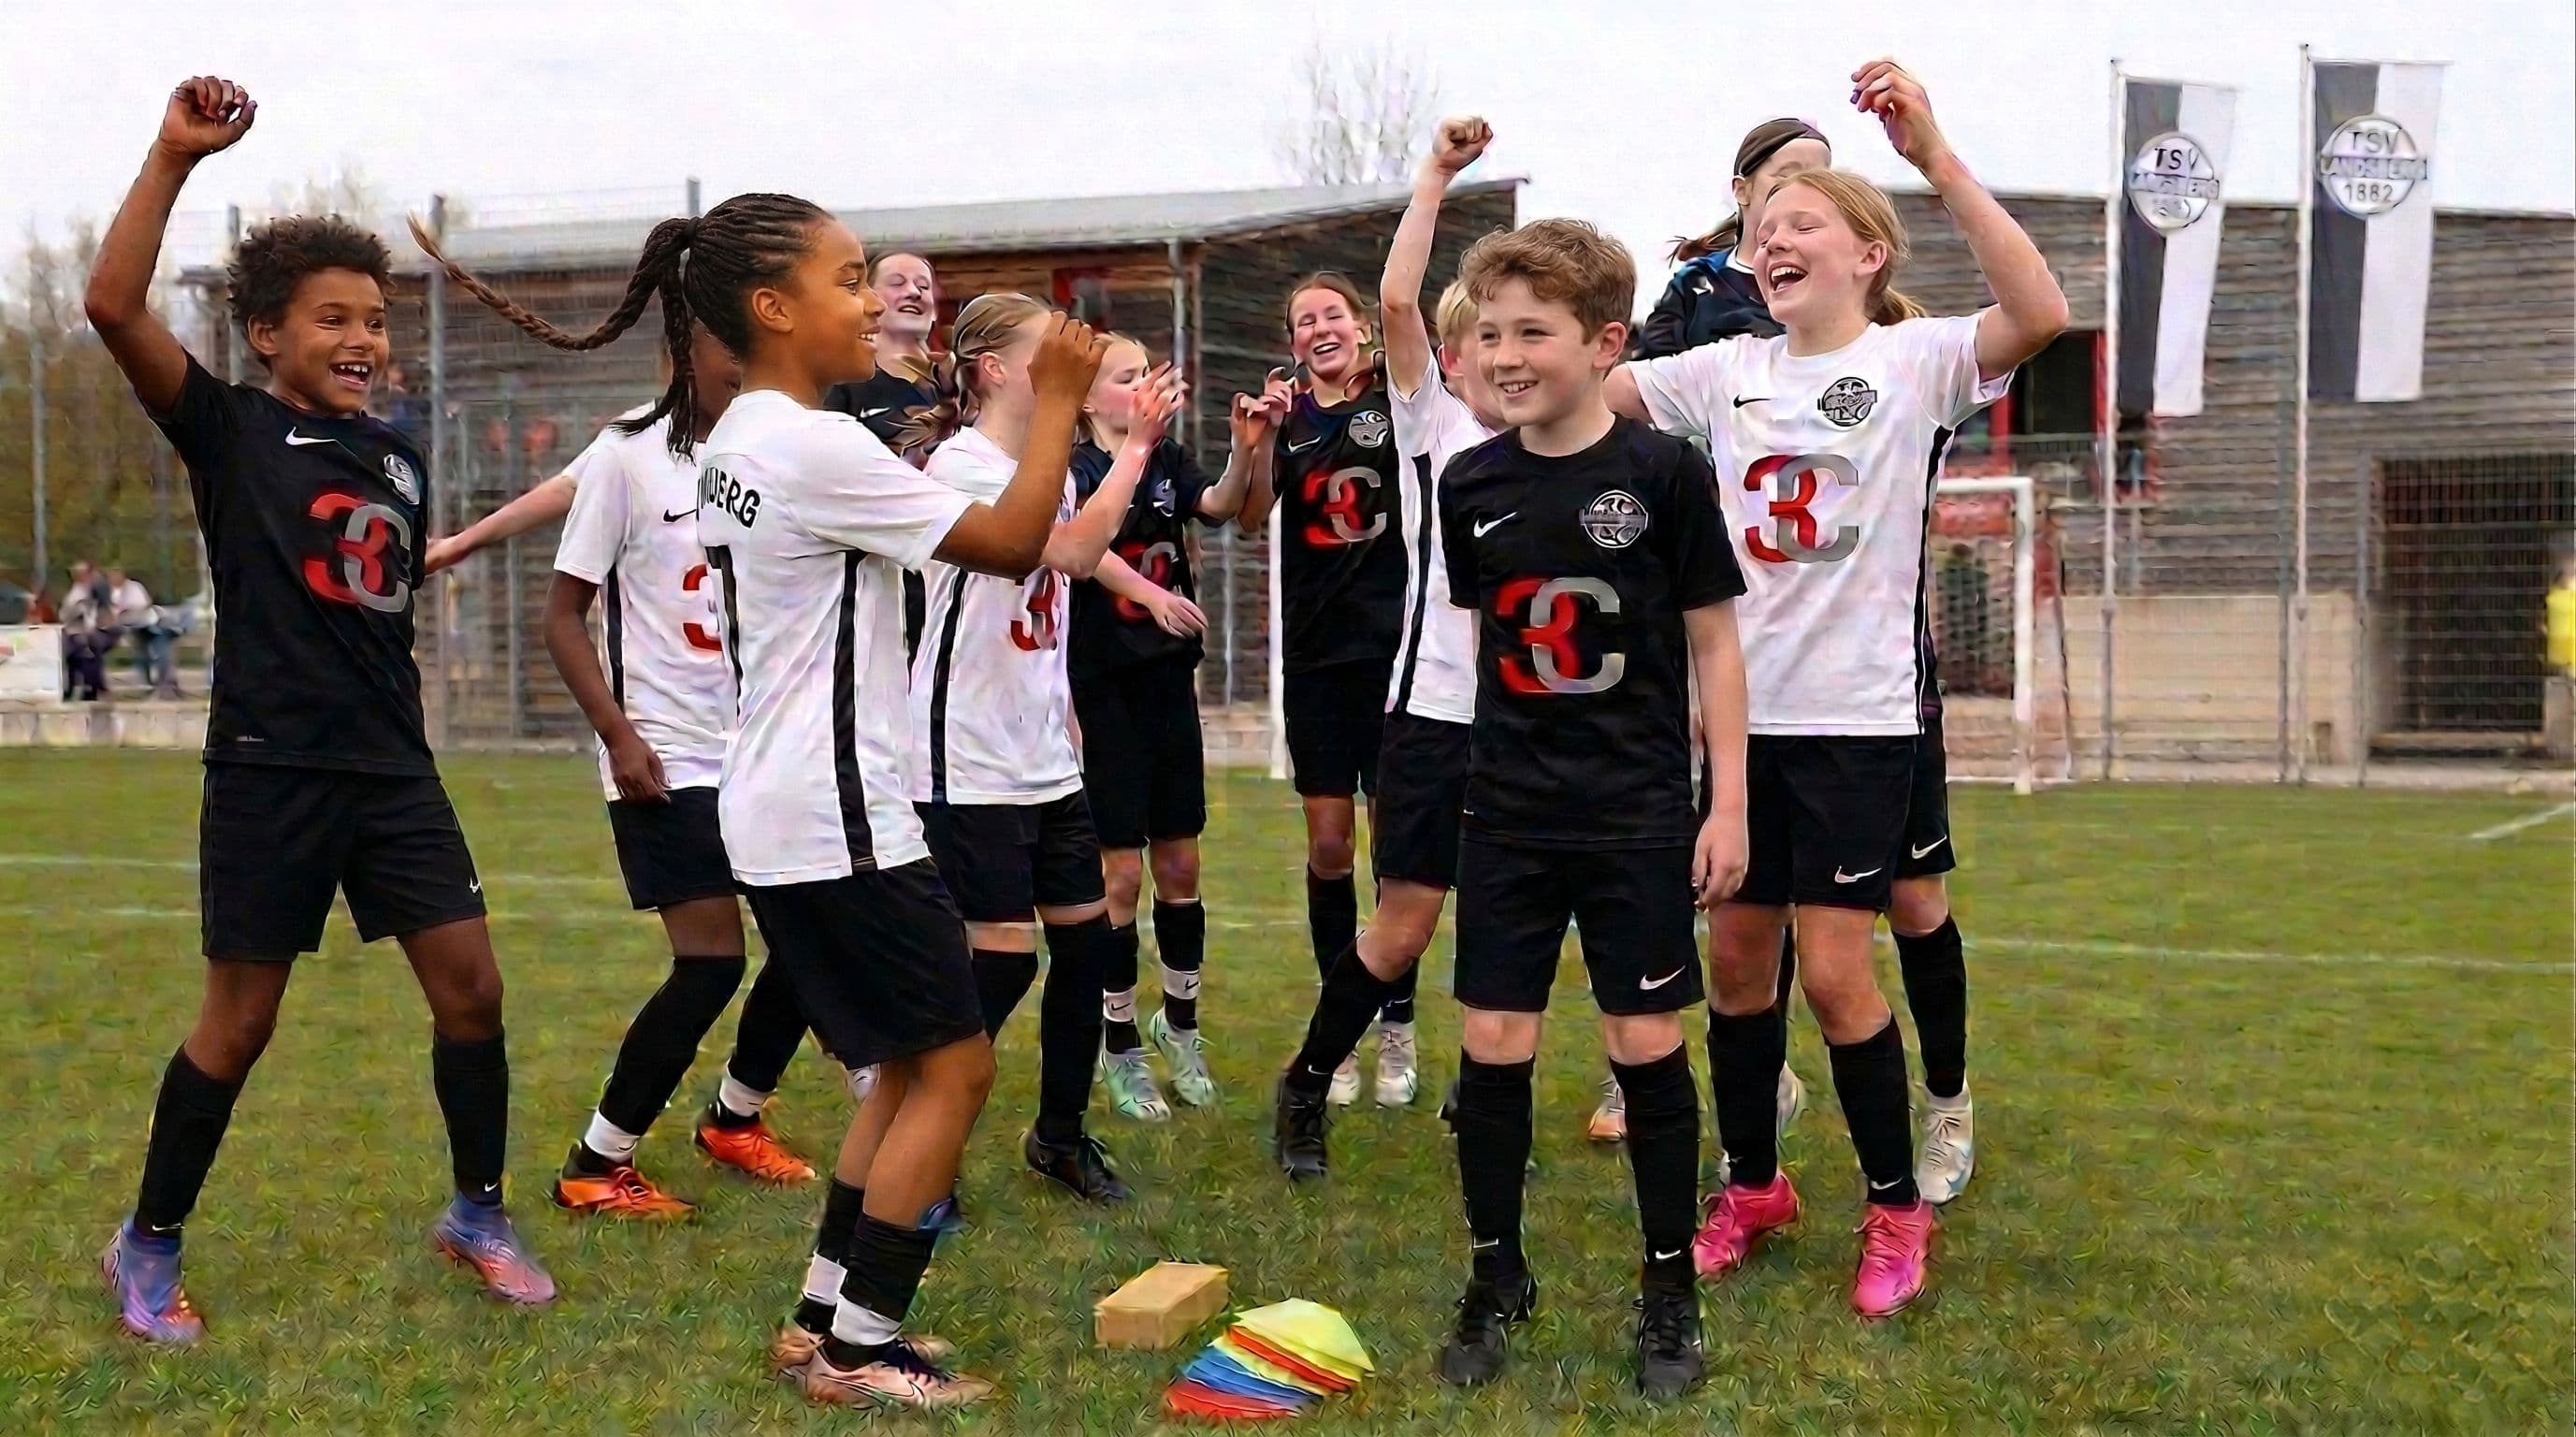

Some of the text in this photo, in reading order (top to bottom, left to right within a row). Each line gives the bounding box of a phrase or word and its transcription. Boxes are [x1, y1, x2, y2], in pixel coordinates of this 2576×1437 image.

[2349, 130, 2400, 153] TSV
[2154, 147, 2200, 170] TSV
[2343, 183, 2394, 203] 1882
[1743, 453, 1860, 564] 3C
[1495, 575, 1627, 694] 3C
